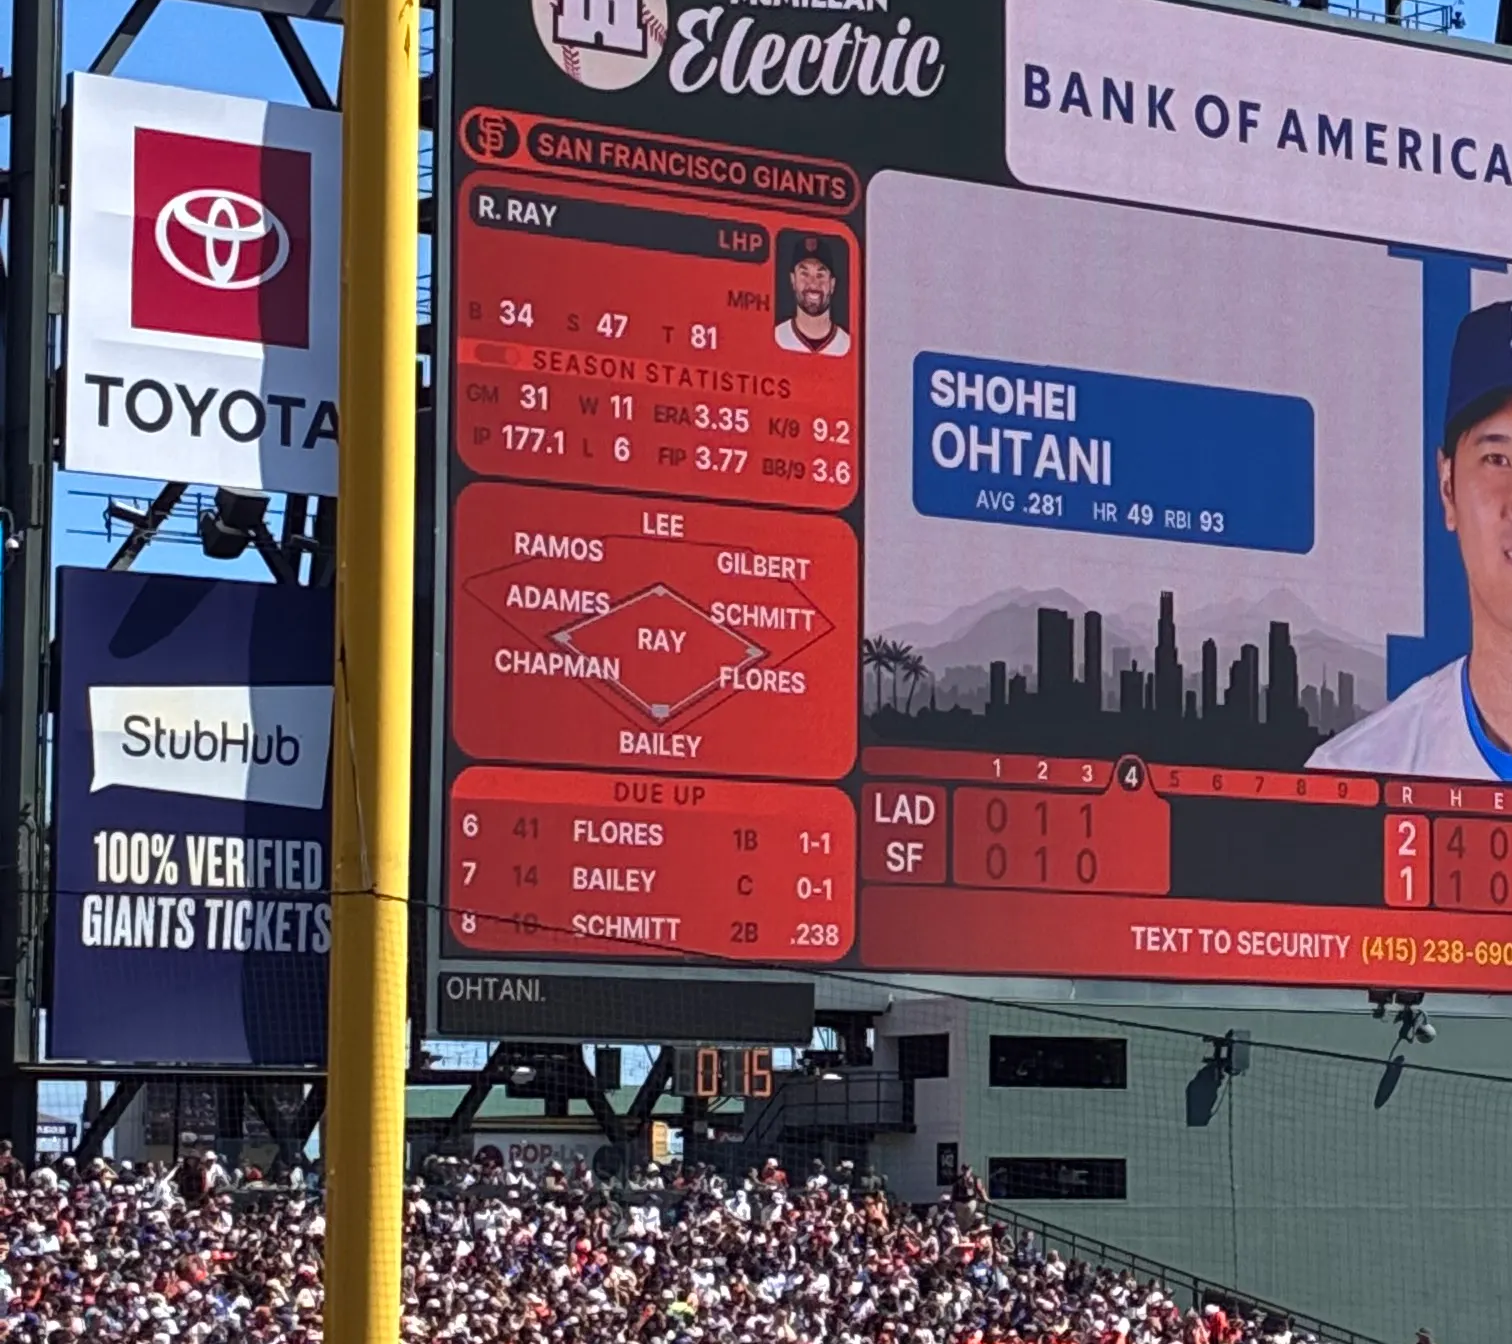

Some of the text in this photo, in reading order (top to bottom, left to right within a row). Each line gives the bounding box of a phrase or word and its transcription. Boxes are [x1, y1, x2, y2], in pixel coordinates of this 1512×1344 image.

[668, 4, 945, 97] Electric
[1023, 63, 1512, 187] BANK OF AMERICA
[537, 133, 592, 163] SAN
[600, 142, 746, 185] FRANCISCO
[753, 160, 846, 200] GIANTS
[478, 195, 763, 252] R. RAY LHP
[499, 300, 534, 329] 34
[596, 313, 628, 339] 47
[690, 325, 717, 350] 81
[533, 350, 791, 399] SEASON STATISTICS
[519, 384, 549, 411] 31
[611, 395, 633, 421] 11
[930, 369, 1076, 421] SHOHEI
[85, 373, 339, 449] TOYOTA
[694, 405, 749, 433] 3.35
[501, 425, 565, 454] 177.1
[813, 417, 850, 445] 9.2
[614, 437, 630, 461] 6
[695, 447, 747, 474] 3.77
[932, 422, 1111, 486] OHTANI
[812, 460, 851, 485] 3.6
[642, 512, 684, 538] LEE
[976, 490, 1224, 533] AVG .281 HR 49 RBI 93
[514, 532, 603, 562] RAMOS
[717, 552, 810, 581] GILBERT
[506, 585, 610, 614] ADAMES
[711, 602, 815, 631] SCHMITT
[638, 628, 686, 654] RAY
[494, 649, 620, 680] CHAPMAN
[719, 666, 806, 693] FLORES
[122, 715, 300, 766] StubHub
[619, 732, 702, 758] BAILEY
[614, 782, 705, 805] DUE UP
[874, 793, 935, 826] LAD
[573, 819, 831, 854] FLORES 1-1
[95, 831, 322, 890] 100% VERIFIED
[886, 842, 924, 872] SF
[572, 867, 833, 901] BAILEY 0-1
[83, 895, 332, 954] GIANTS TICKETS
[572, 914, 839, 946] SCHMITT .238
[1131, 926, 1192, 952] TEXT
[1199, 929, 1231, 955] TO
[1237, 930, 1350, 960] SECURITY
[1361, 937, 1417, 967] (415)
[446, 977, 546, 1002] OHTANI.
